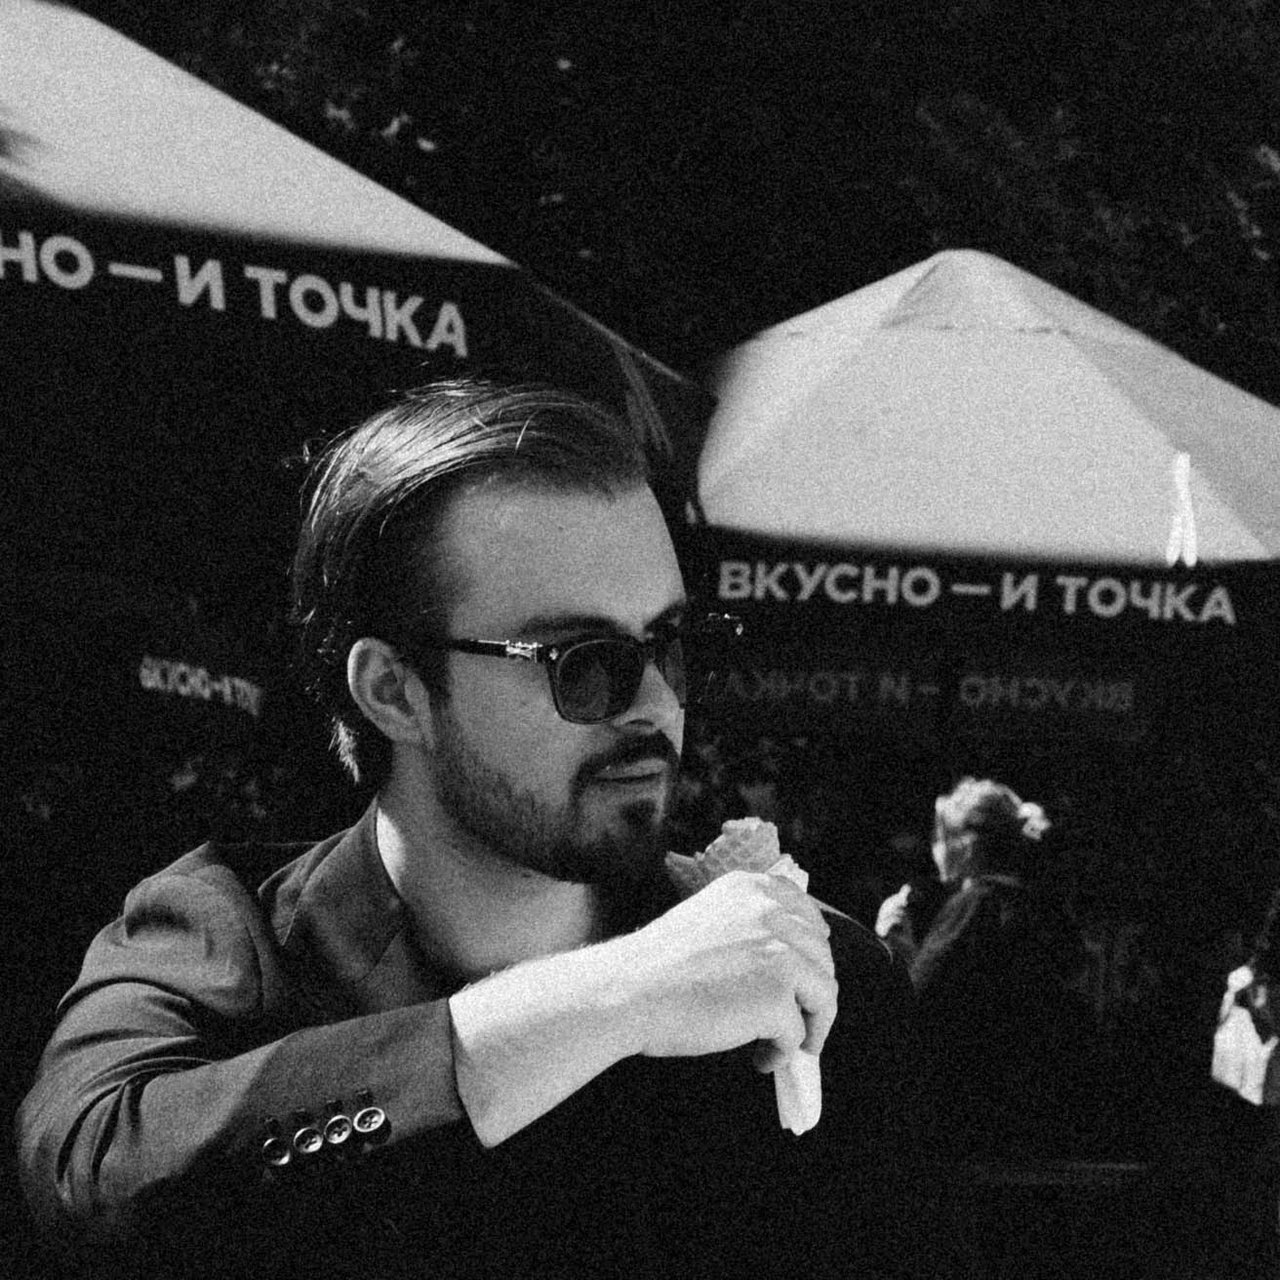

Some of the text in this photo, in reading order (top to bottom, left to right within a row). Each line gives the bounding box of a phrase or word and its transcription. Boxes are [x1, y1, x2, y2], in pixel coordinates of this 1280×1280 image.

[174, 254, 226, 312] И
[243, 264, 468, 359] ТОЧКА
[718, 562, 941, 607] ВКУСНО
[1000, 572, 1038, 612] И
[1055, 575, 1236, 624] ТОЧКА
